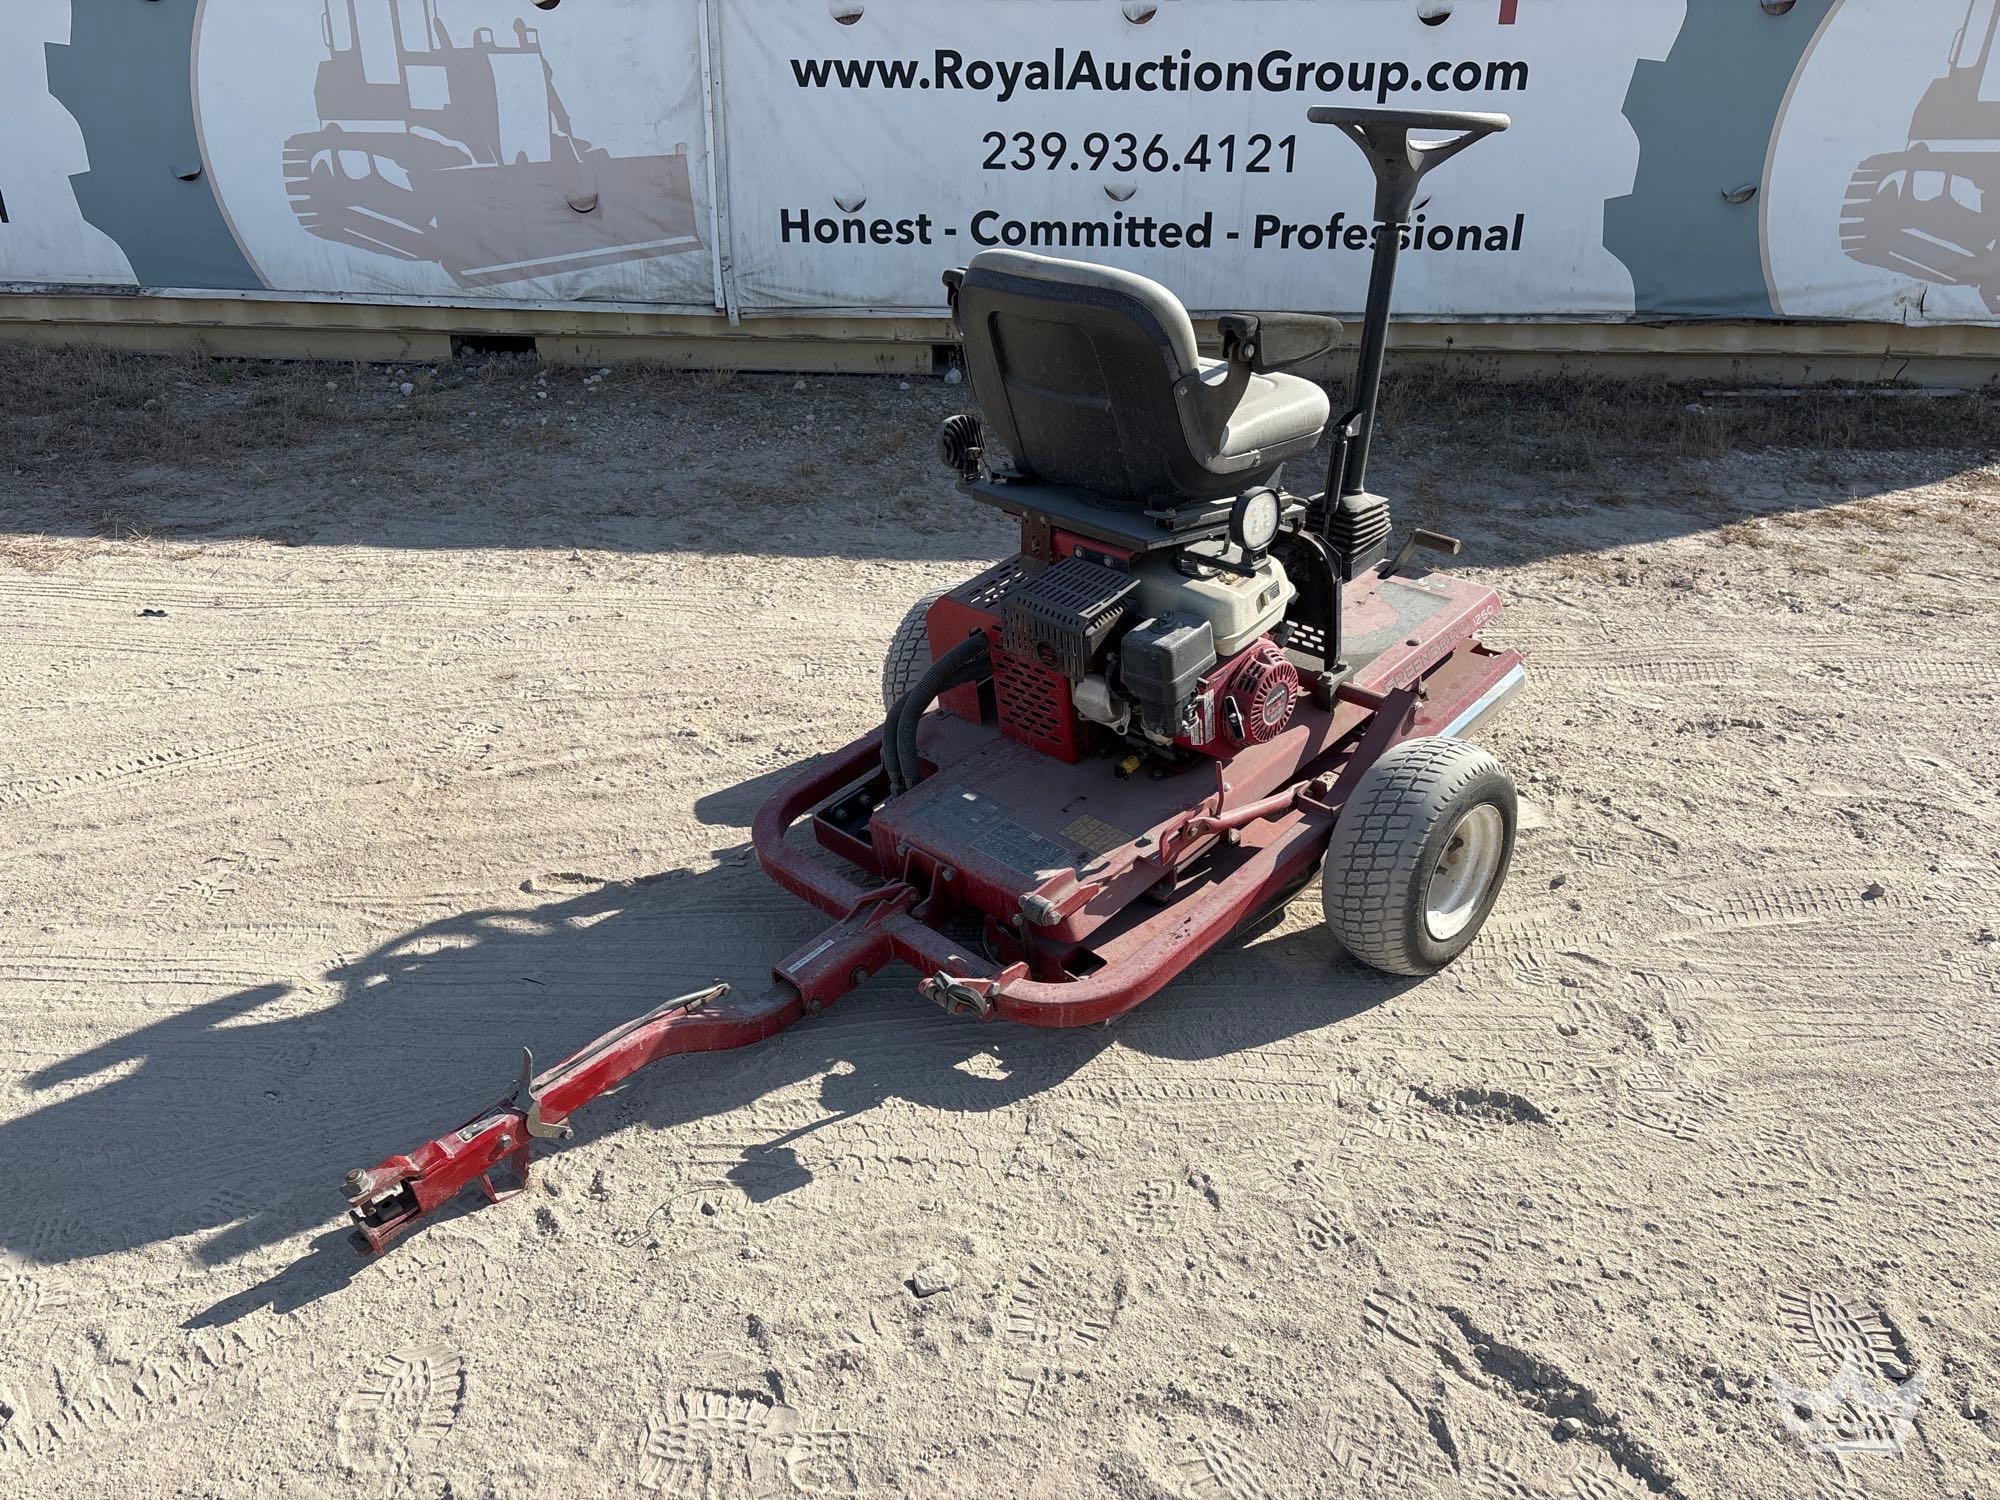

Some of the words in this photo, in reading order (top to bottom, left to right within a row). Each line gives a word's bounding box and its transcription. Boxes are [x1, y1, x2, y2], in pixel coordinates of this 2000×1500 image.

[789, 47, 1529, 104] www.RoyalAuctionGroup.com
[982, 131, 1297, 173] 239.936.4121
[780, 208, 932, 245] Honest
[970, 209, 1213, 249] Committed
[1472, 604, 1496, 628] 1260
